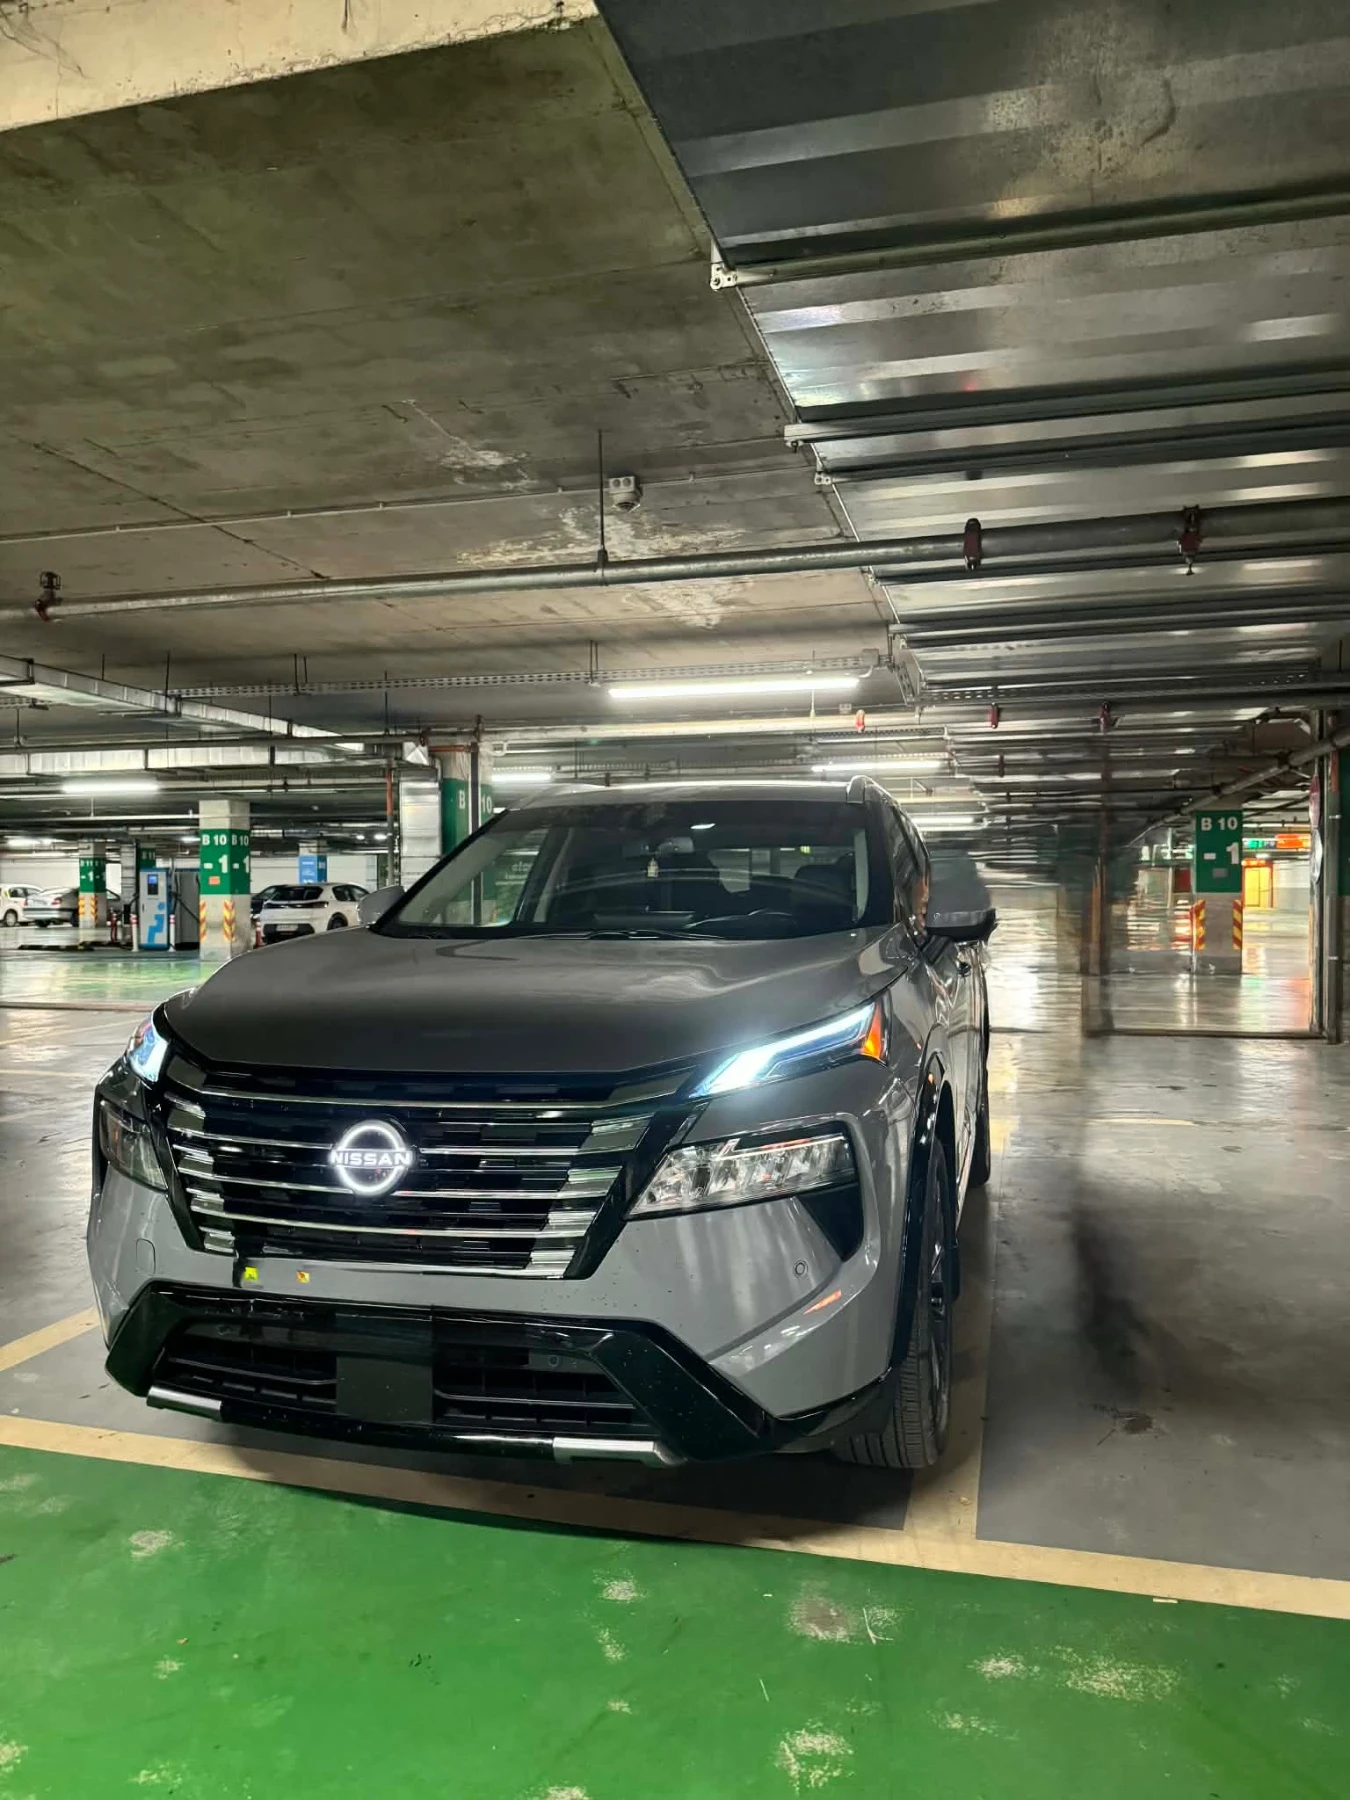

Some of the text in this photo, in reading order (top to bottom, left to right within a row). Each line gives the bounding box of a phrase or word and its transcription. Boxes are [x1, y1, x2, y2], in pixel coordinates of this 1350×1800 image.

[459, 790, 492, 814] B 10
[1201, 816, 1238, 831] B 10
[202, 834, 227, 846] B 10
[231, 834, 249, 846] B 10
[330, 1152, 411, 1166] NISSAN
